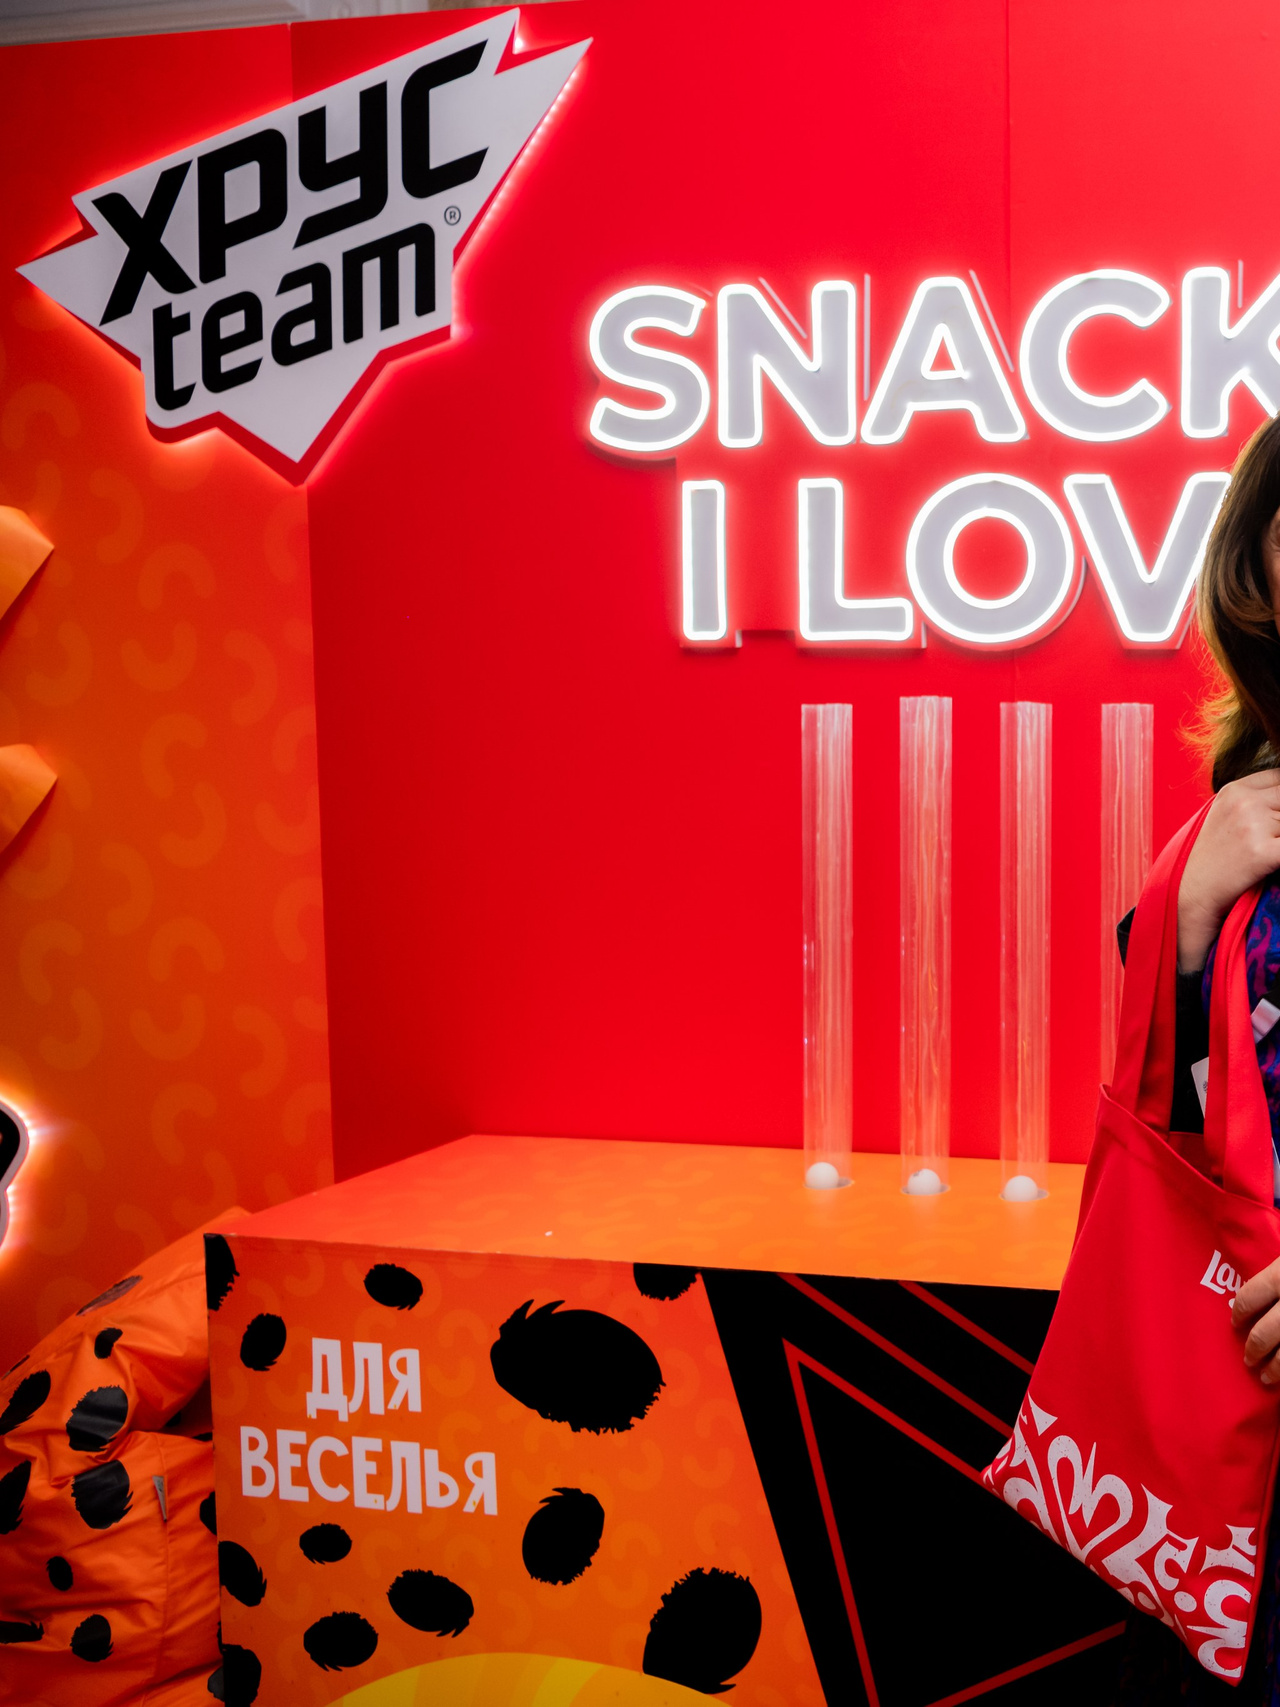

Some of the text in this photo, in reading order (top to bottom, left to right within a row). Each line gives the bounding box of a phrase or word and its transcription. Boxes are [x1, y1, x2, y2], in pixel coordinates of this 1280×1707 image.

[152, 223, 436, 411] team
[681, 472, 1233, 643] I LOV
[306, 1337, 422, 1422] ДЛЯ
[240, 1426, 498, 1516] ВЕСЕЛЬЯ
